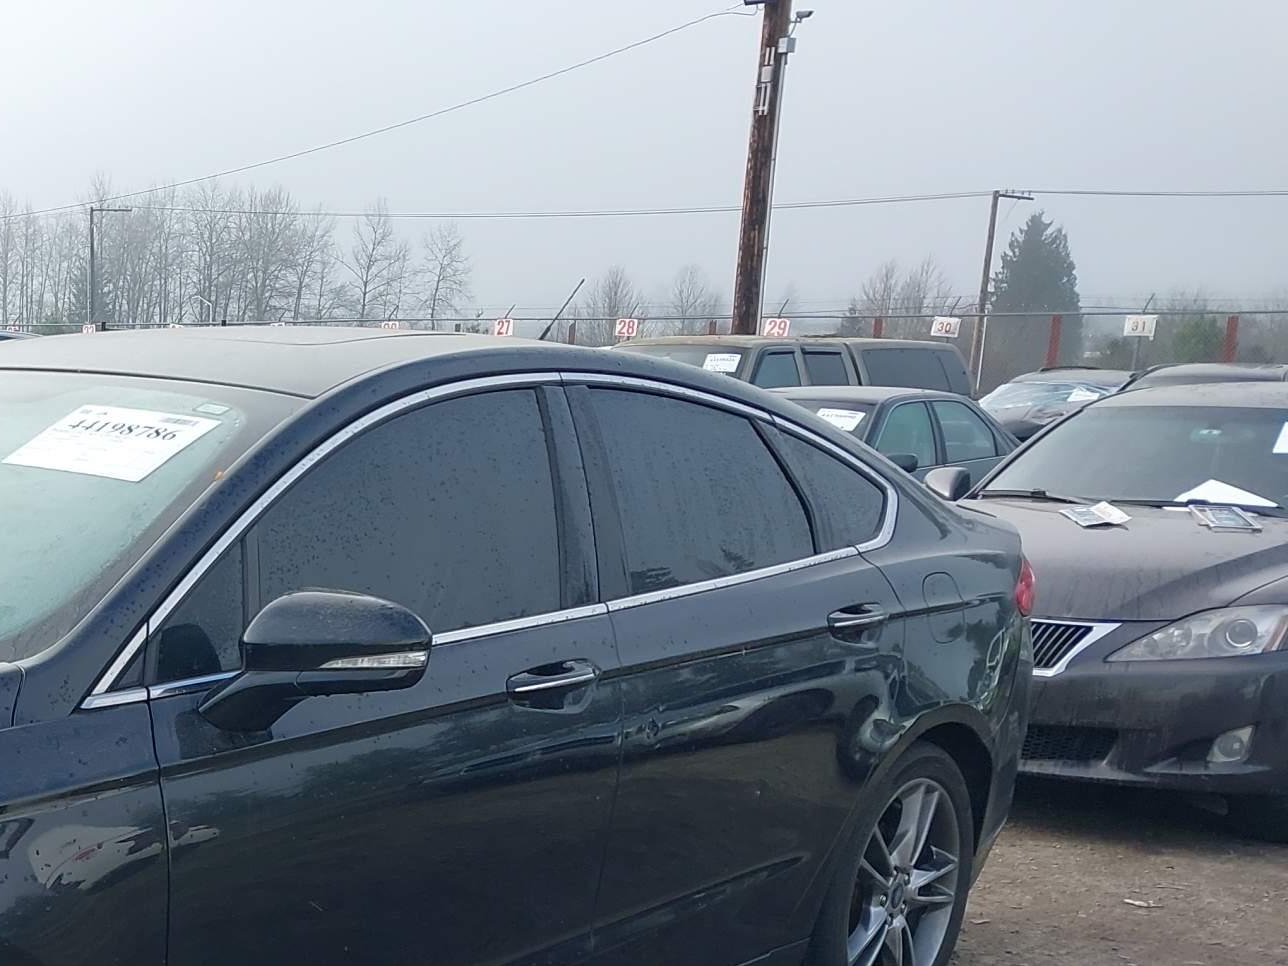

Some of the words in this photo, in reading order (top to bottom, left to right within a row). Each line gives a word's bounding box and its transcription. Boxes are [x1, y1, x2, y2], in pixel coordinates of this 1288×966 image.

[496, 320, 511, 335] 27
[617, 319, 636, 335] 28
[767, 320, 788, 336] 29
[937, 321, 953, 333] 30
[1131, 320, 1146, 332] 31
[67, 419, 183, 441] 44198786
